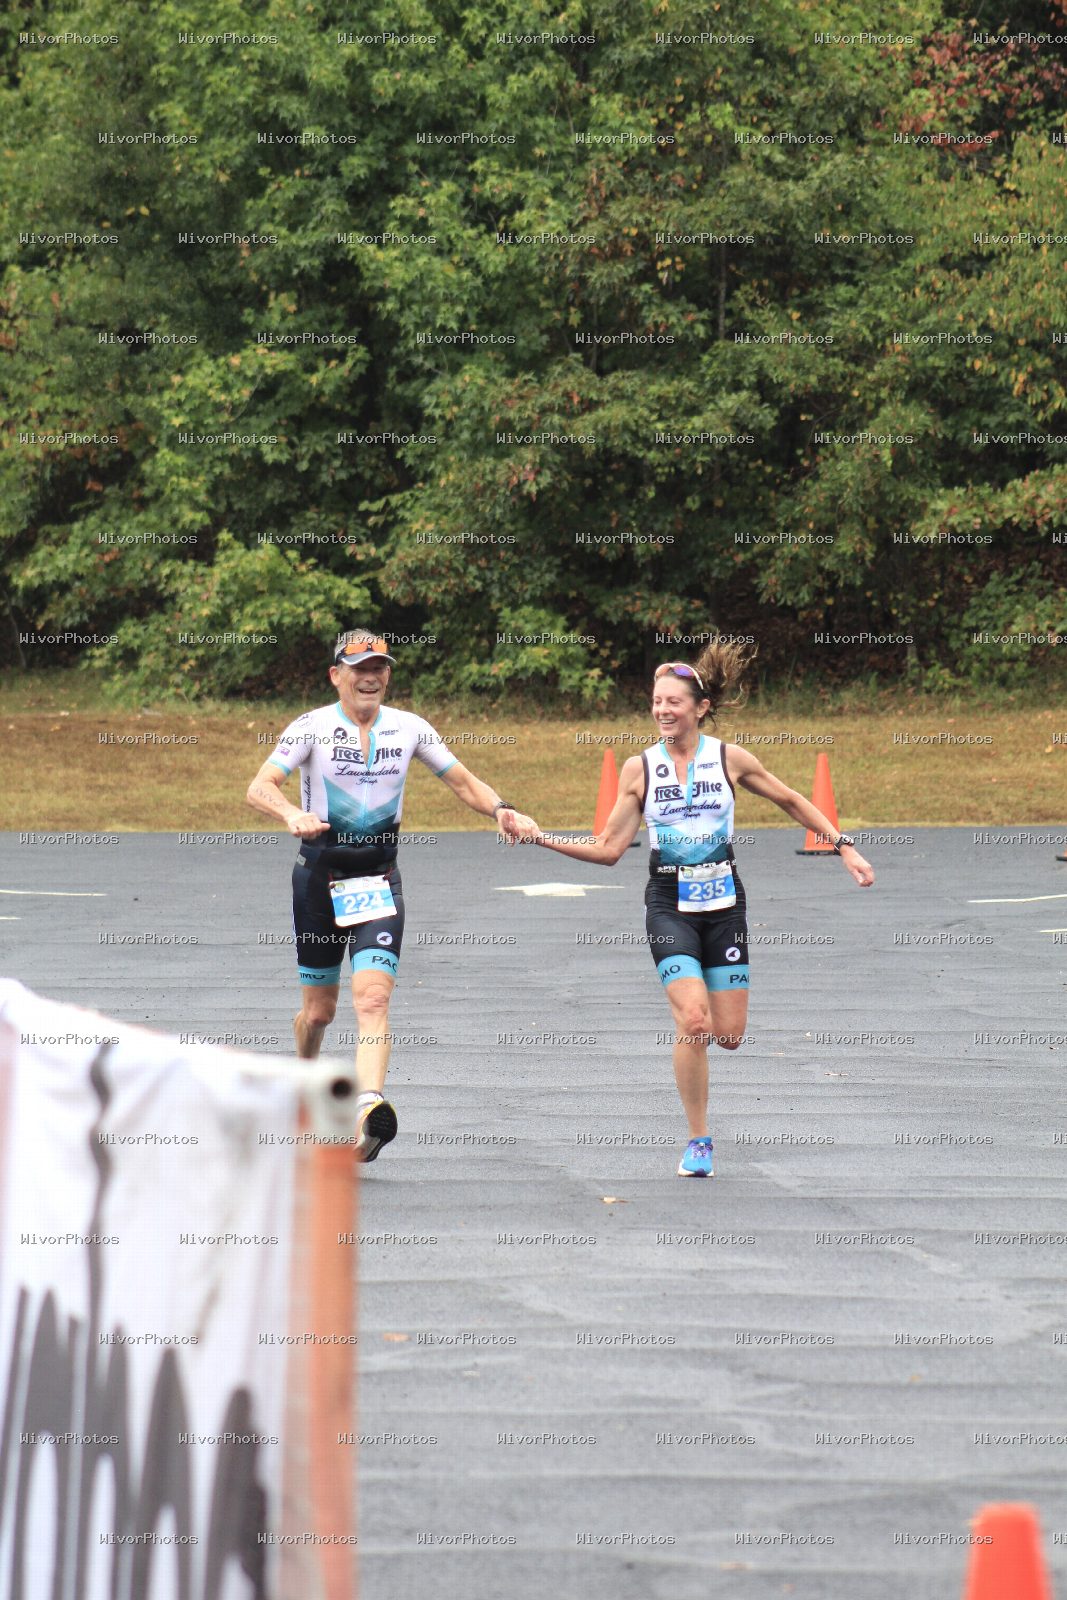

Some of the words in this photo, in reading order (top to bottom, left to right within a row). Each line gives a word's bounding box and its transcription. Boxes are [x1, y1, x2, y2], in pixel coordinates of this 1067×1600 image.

[688, 880, 726, 901] 235
[343, 891, 385, 914] 224
[729, 974, 750, 984] PA
